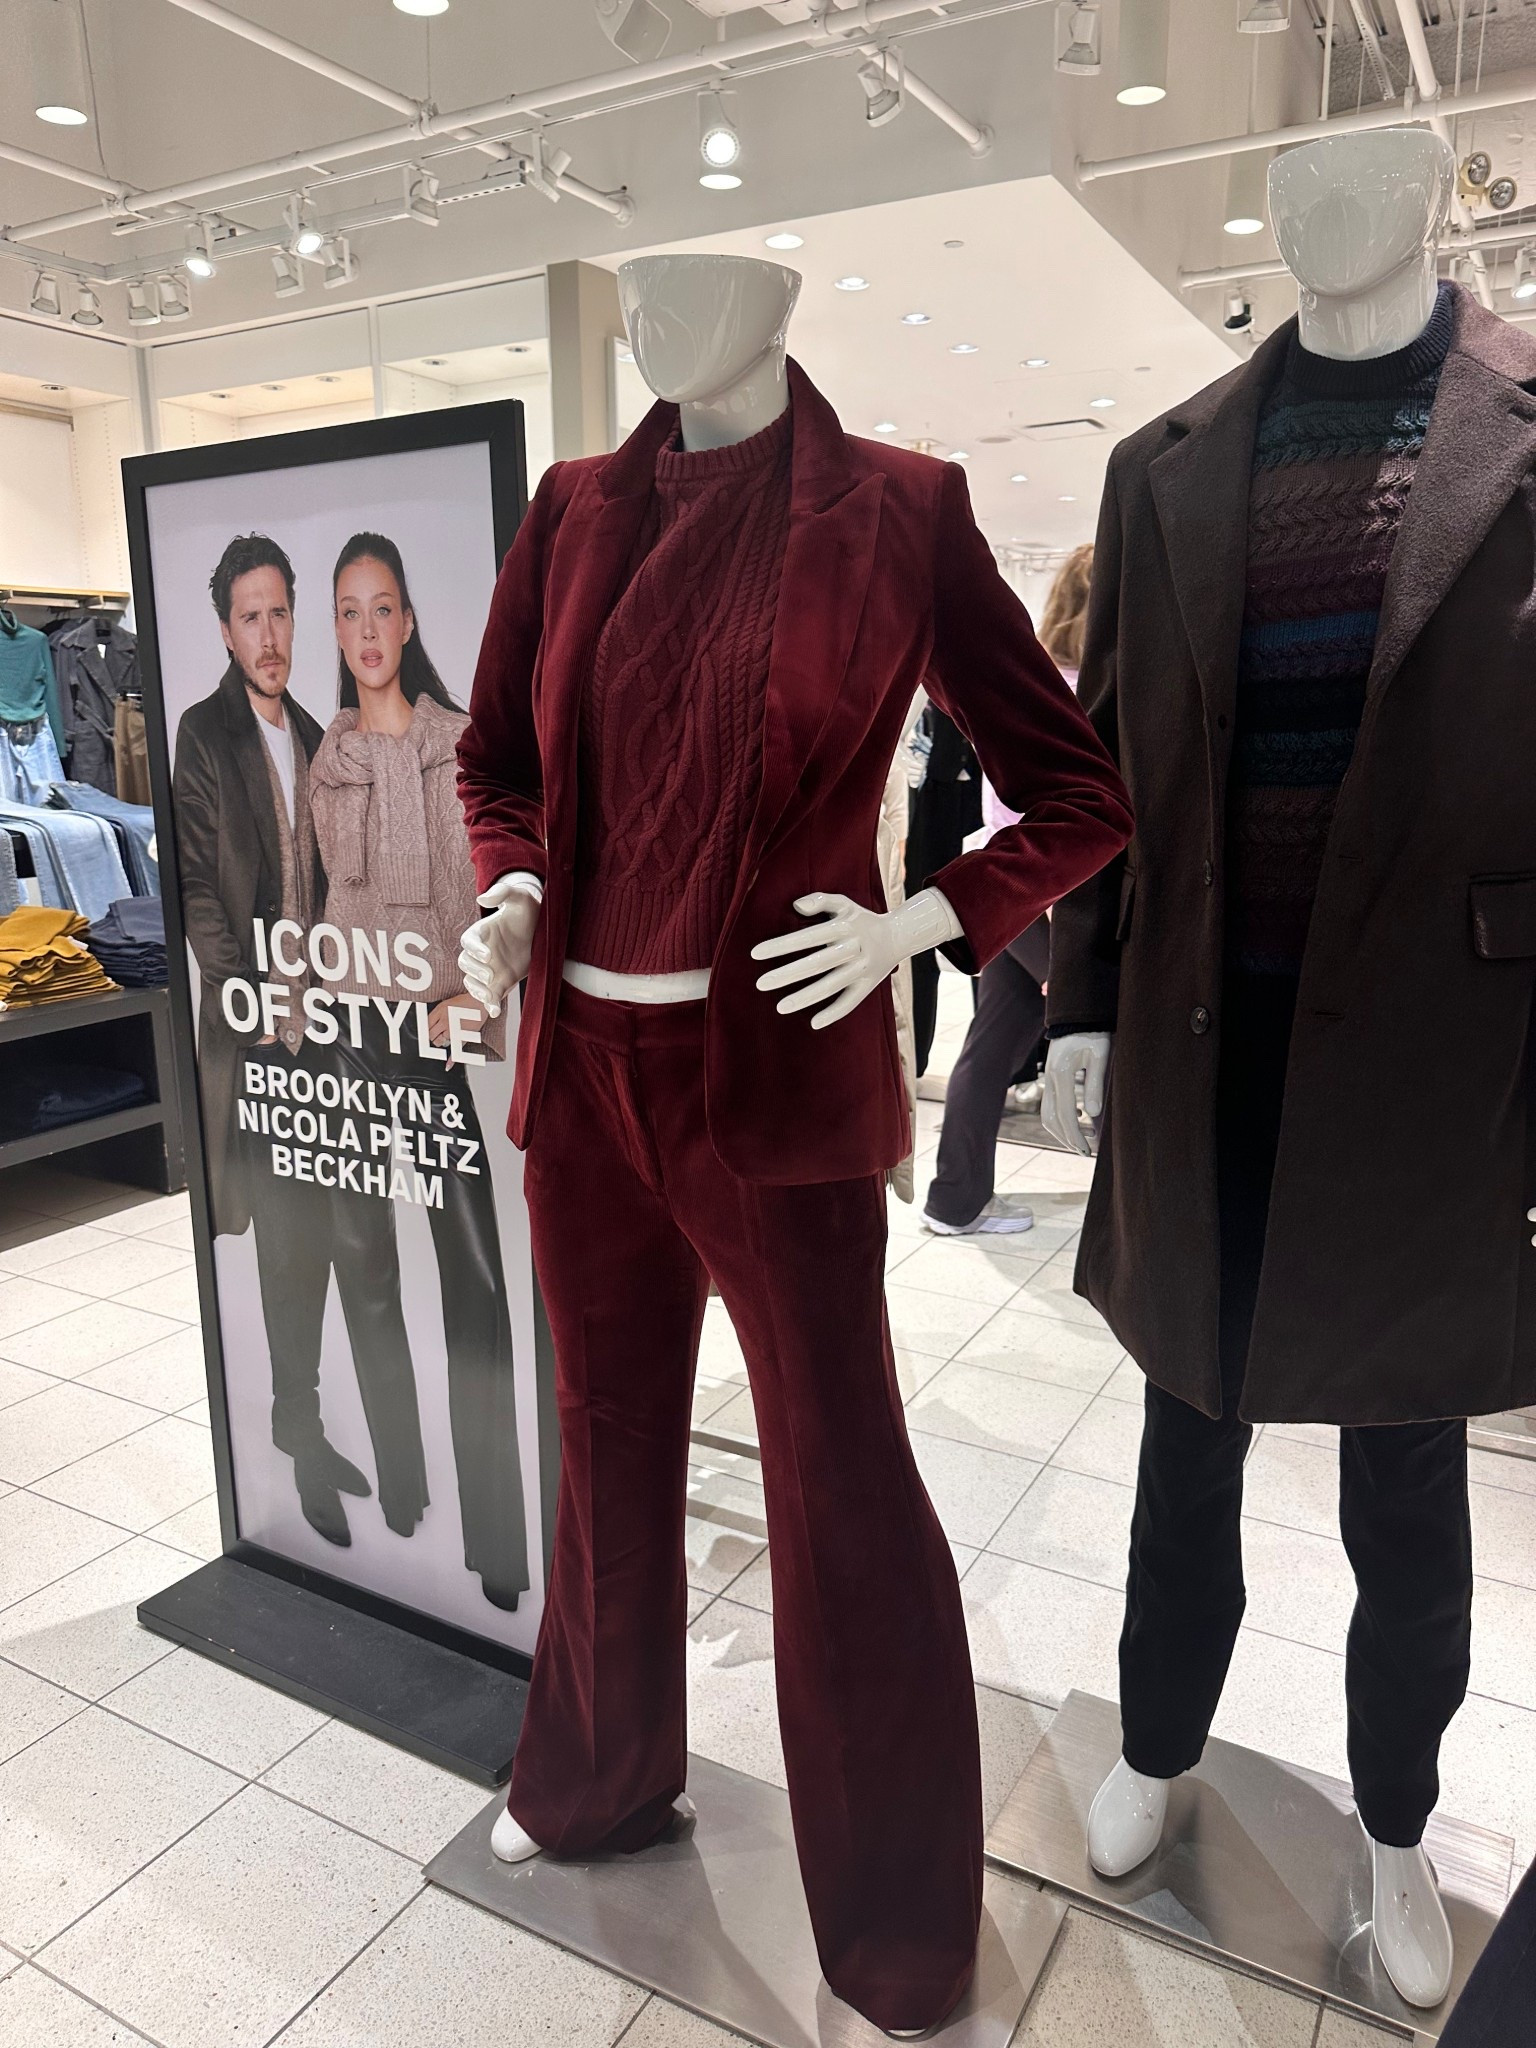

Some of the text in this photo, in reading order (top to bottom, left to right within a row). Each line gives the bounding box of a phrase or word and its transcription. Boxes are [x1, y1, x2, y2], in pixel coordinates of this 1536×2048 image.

[253, 918, 433, 992] ICONS
[222, 977, 486, 1067] OF STYLE
[244, 1061, 466, 1130] BROOKLYN &
[238, 1099, 481, 1175] NICOLA PELTZ
[272, 1144, 444, 1210] BECKHAM
